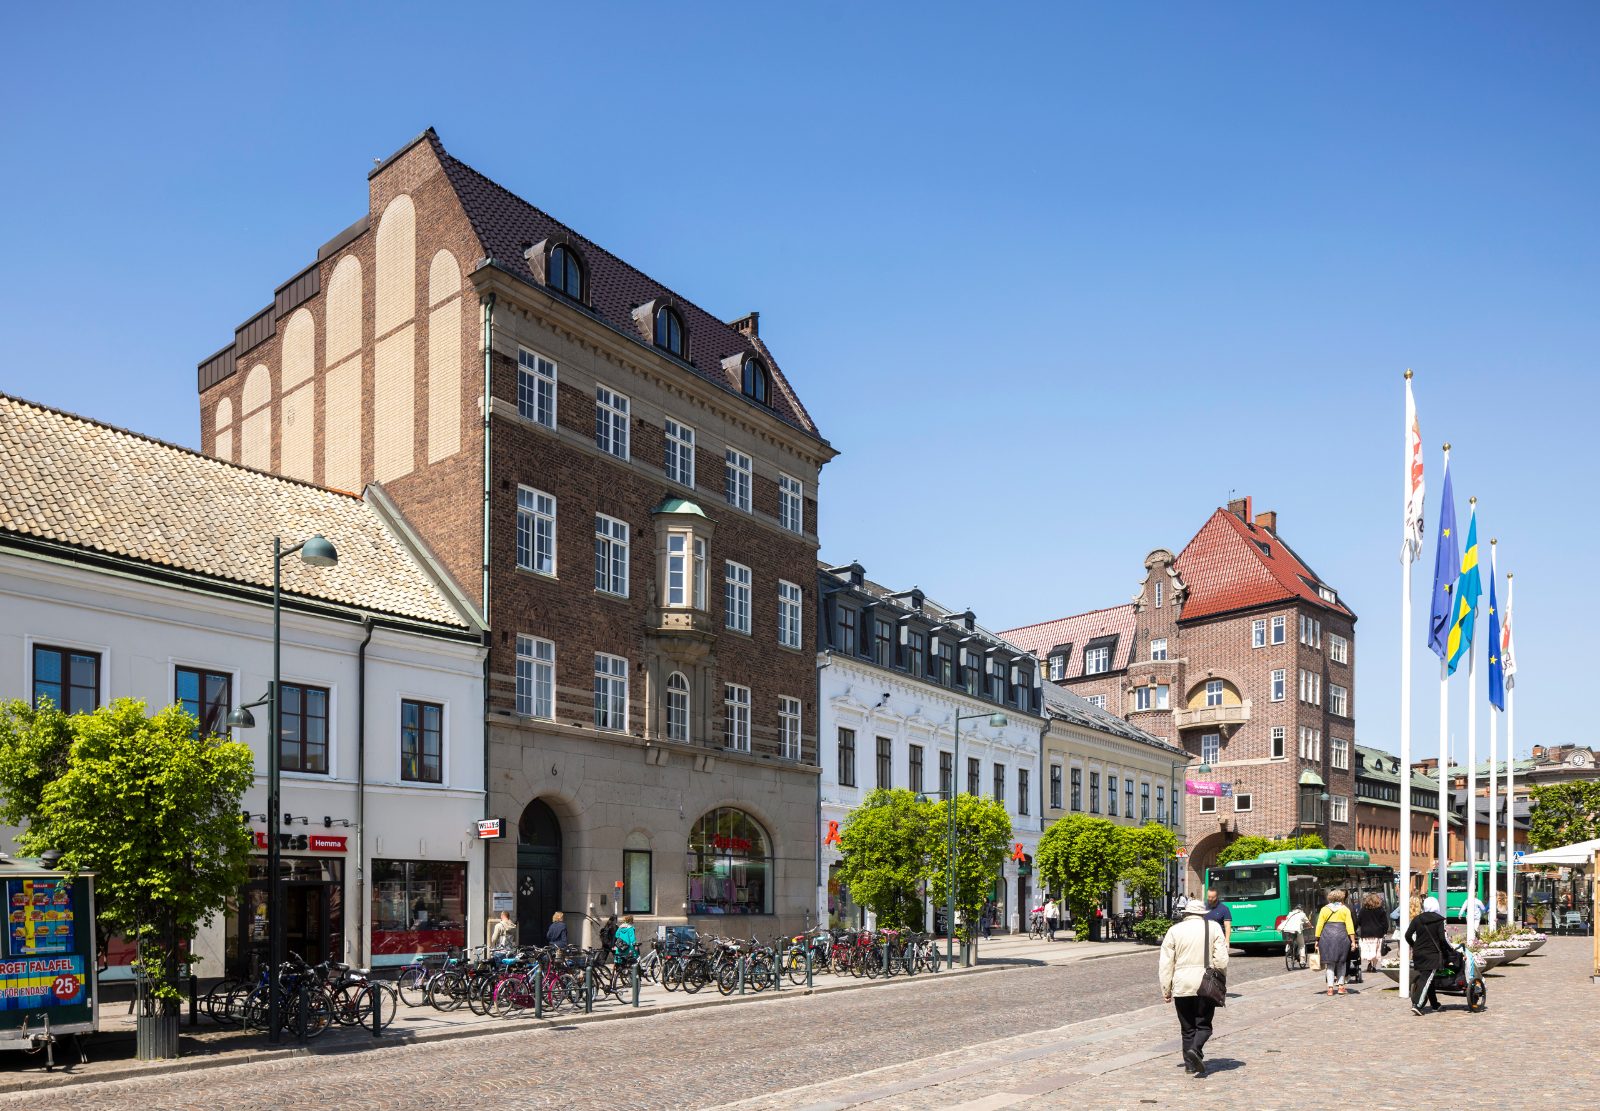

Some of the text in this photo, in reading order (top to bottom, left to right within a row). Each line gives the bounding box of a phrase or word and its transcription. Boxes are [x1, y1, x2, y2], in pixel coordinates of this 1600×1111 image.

[315, 839, 342, 847] Hemma
[29, 959, 74, 973] FALAFEL
[4, 987, 19, 998] FÖR
[20, 985, 49, 996] ENDAST
